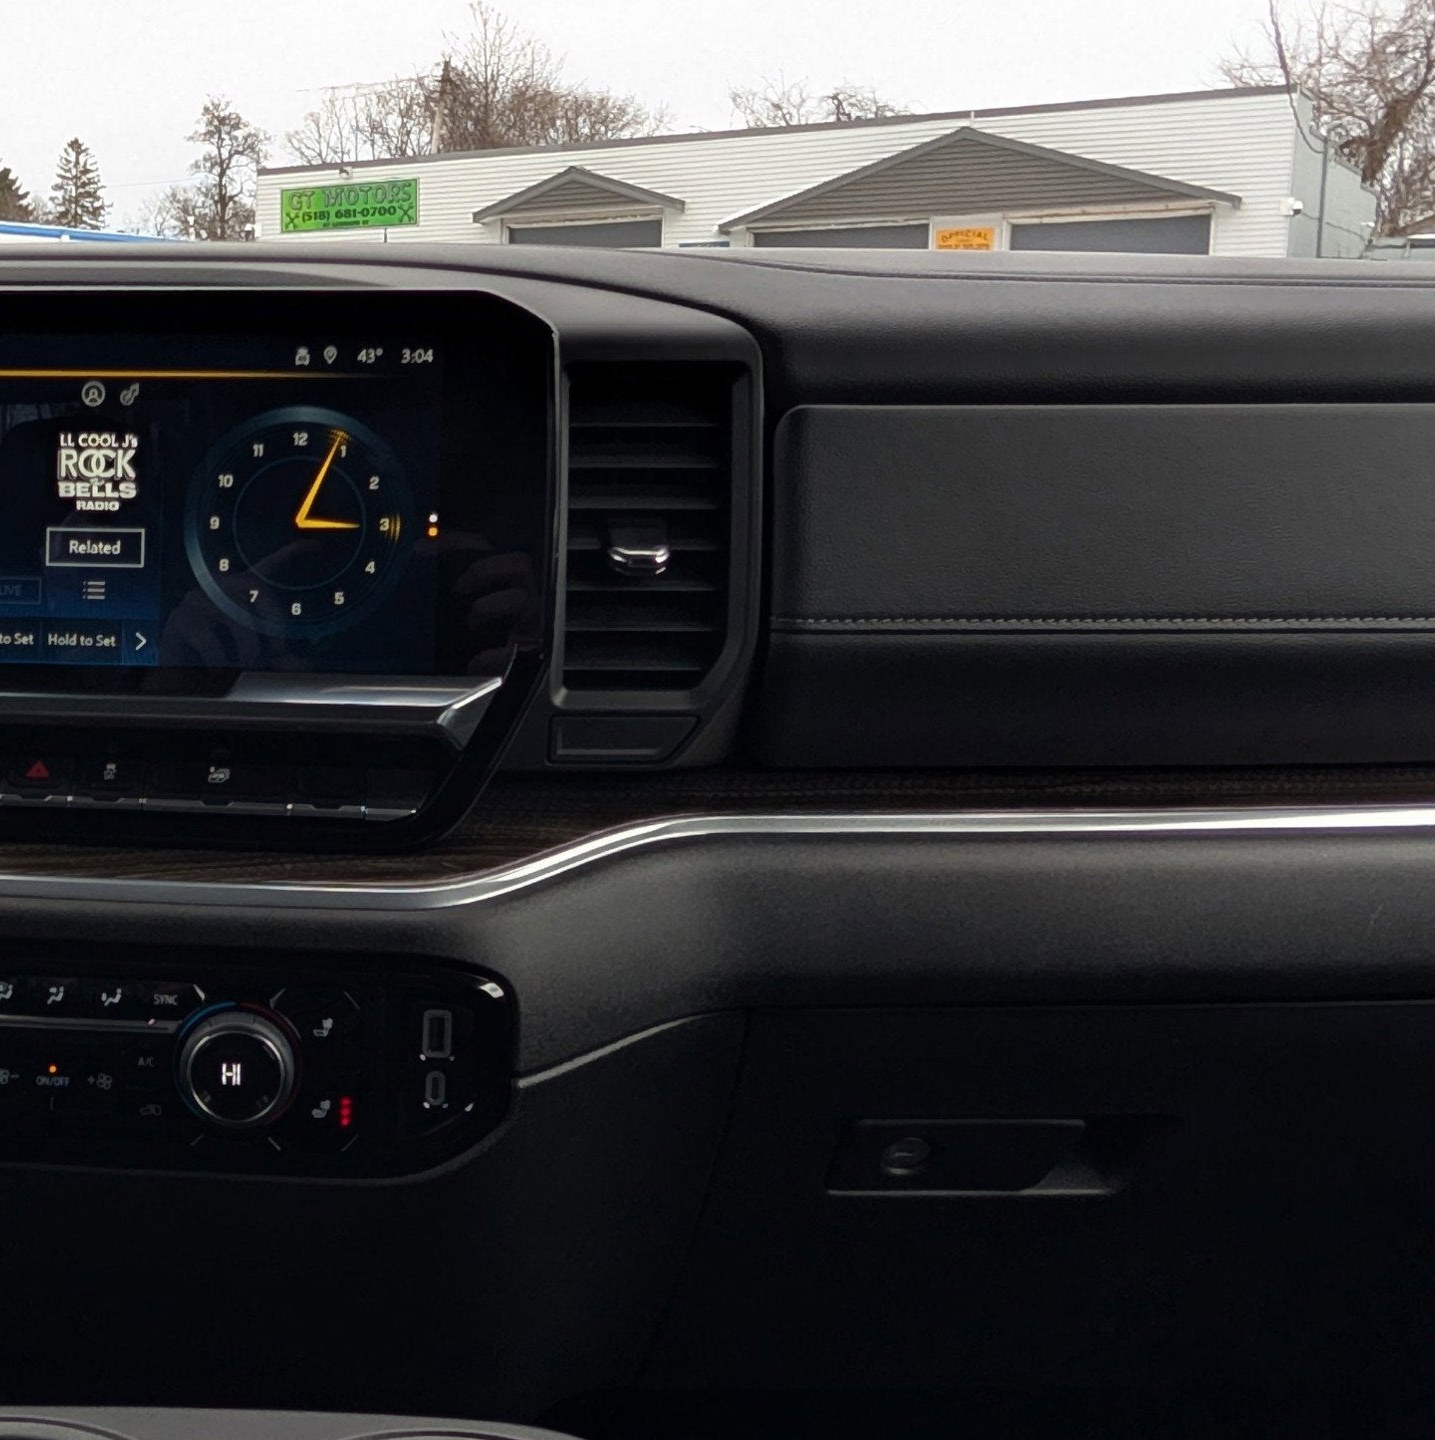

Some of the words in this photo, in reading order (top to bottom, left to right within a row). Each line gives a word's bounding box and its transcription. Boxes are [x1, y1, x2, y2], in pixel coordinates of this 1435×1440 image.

[289, 191, 314, 212] GT
[324, 183, 412, 207] MOTORS
[302, 210, 330, 223] (518)
[335, 206, 397, 219] 681-0700
[357, 348, 384, 363] 43°
[401, 348, 434, 363] 3:04
[60, 433, 75, 447] LL
[78, 433, 119, 447] COOL
[293, 432, 308, 446] 12
[252, 443, 265, 458] 11
[57, 448, 136, 480] ROCK
[218, 474, 234, 488] 10
[57, 482, 137, 499] BELLS
[76, 500, 120, 511] RADIO
[69, 539, 122, 555] Related
[14, 632, 34, 646] Set
[47, 633, 76, 646] Hold
[80, 635, 93, 646] to
[95, 634, 116, 647] Set
[153, 993, 179, 1006] SYNC
[137, 1056, 156, 1067] A/C
[35, 1074, 71, 1087] ON/OFF
[221, 1062, 242, 1086] HI
